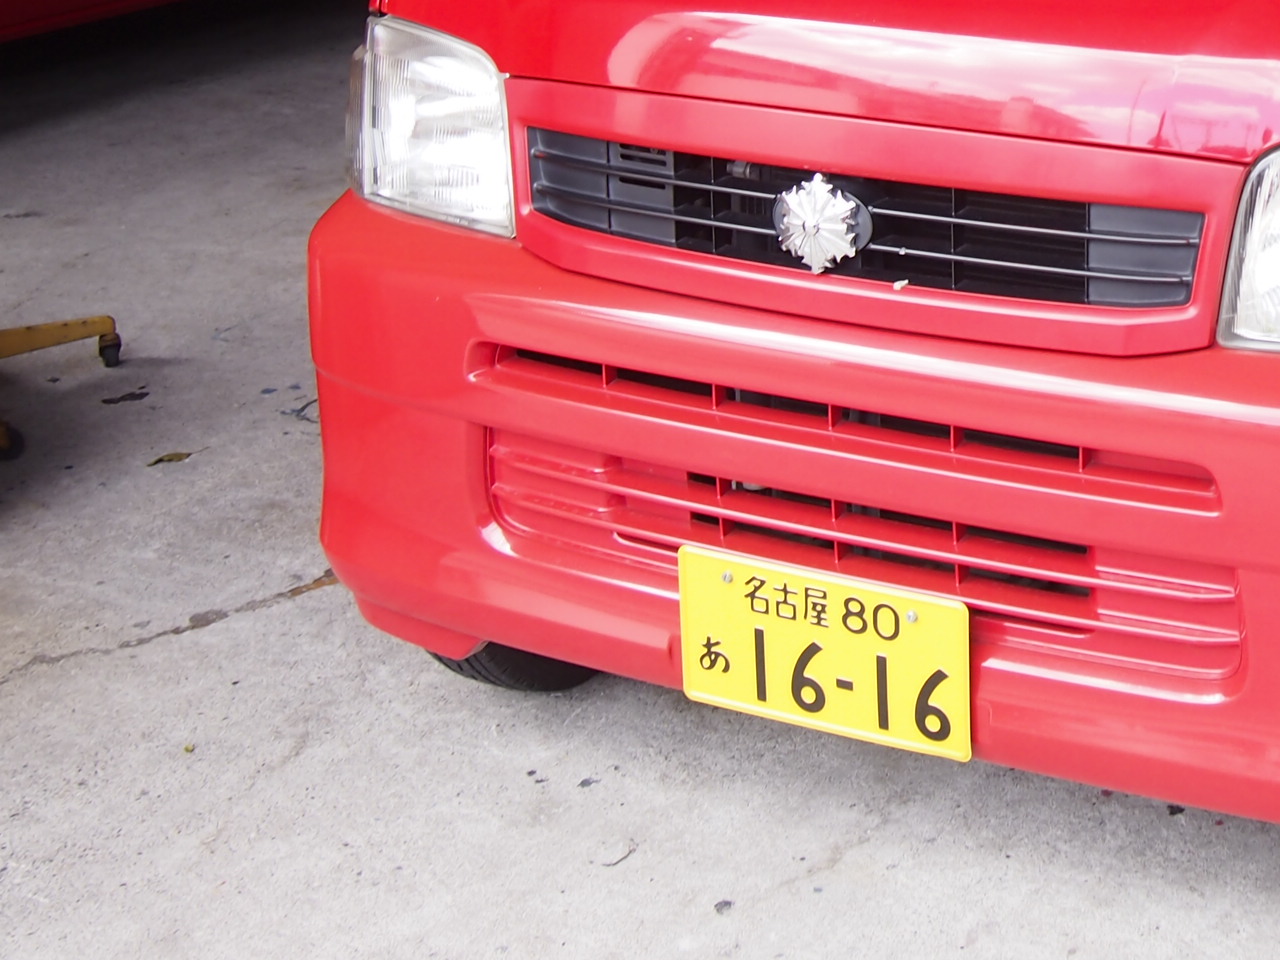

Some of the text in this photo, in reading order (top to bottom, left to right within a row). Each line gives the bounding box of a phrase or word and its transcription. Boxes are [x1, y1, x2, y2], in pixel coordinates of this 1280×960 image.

[744, 576, 901, 642] 名古屋 80
[699, 626, 952, 742] あ 16-16
